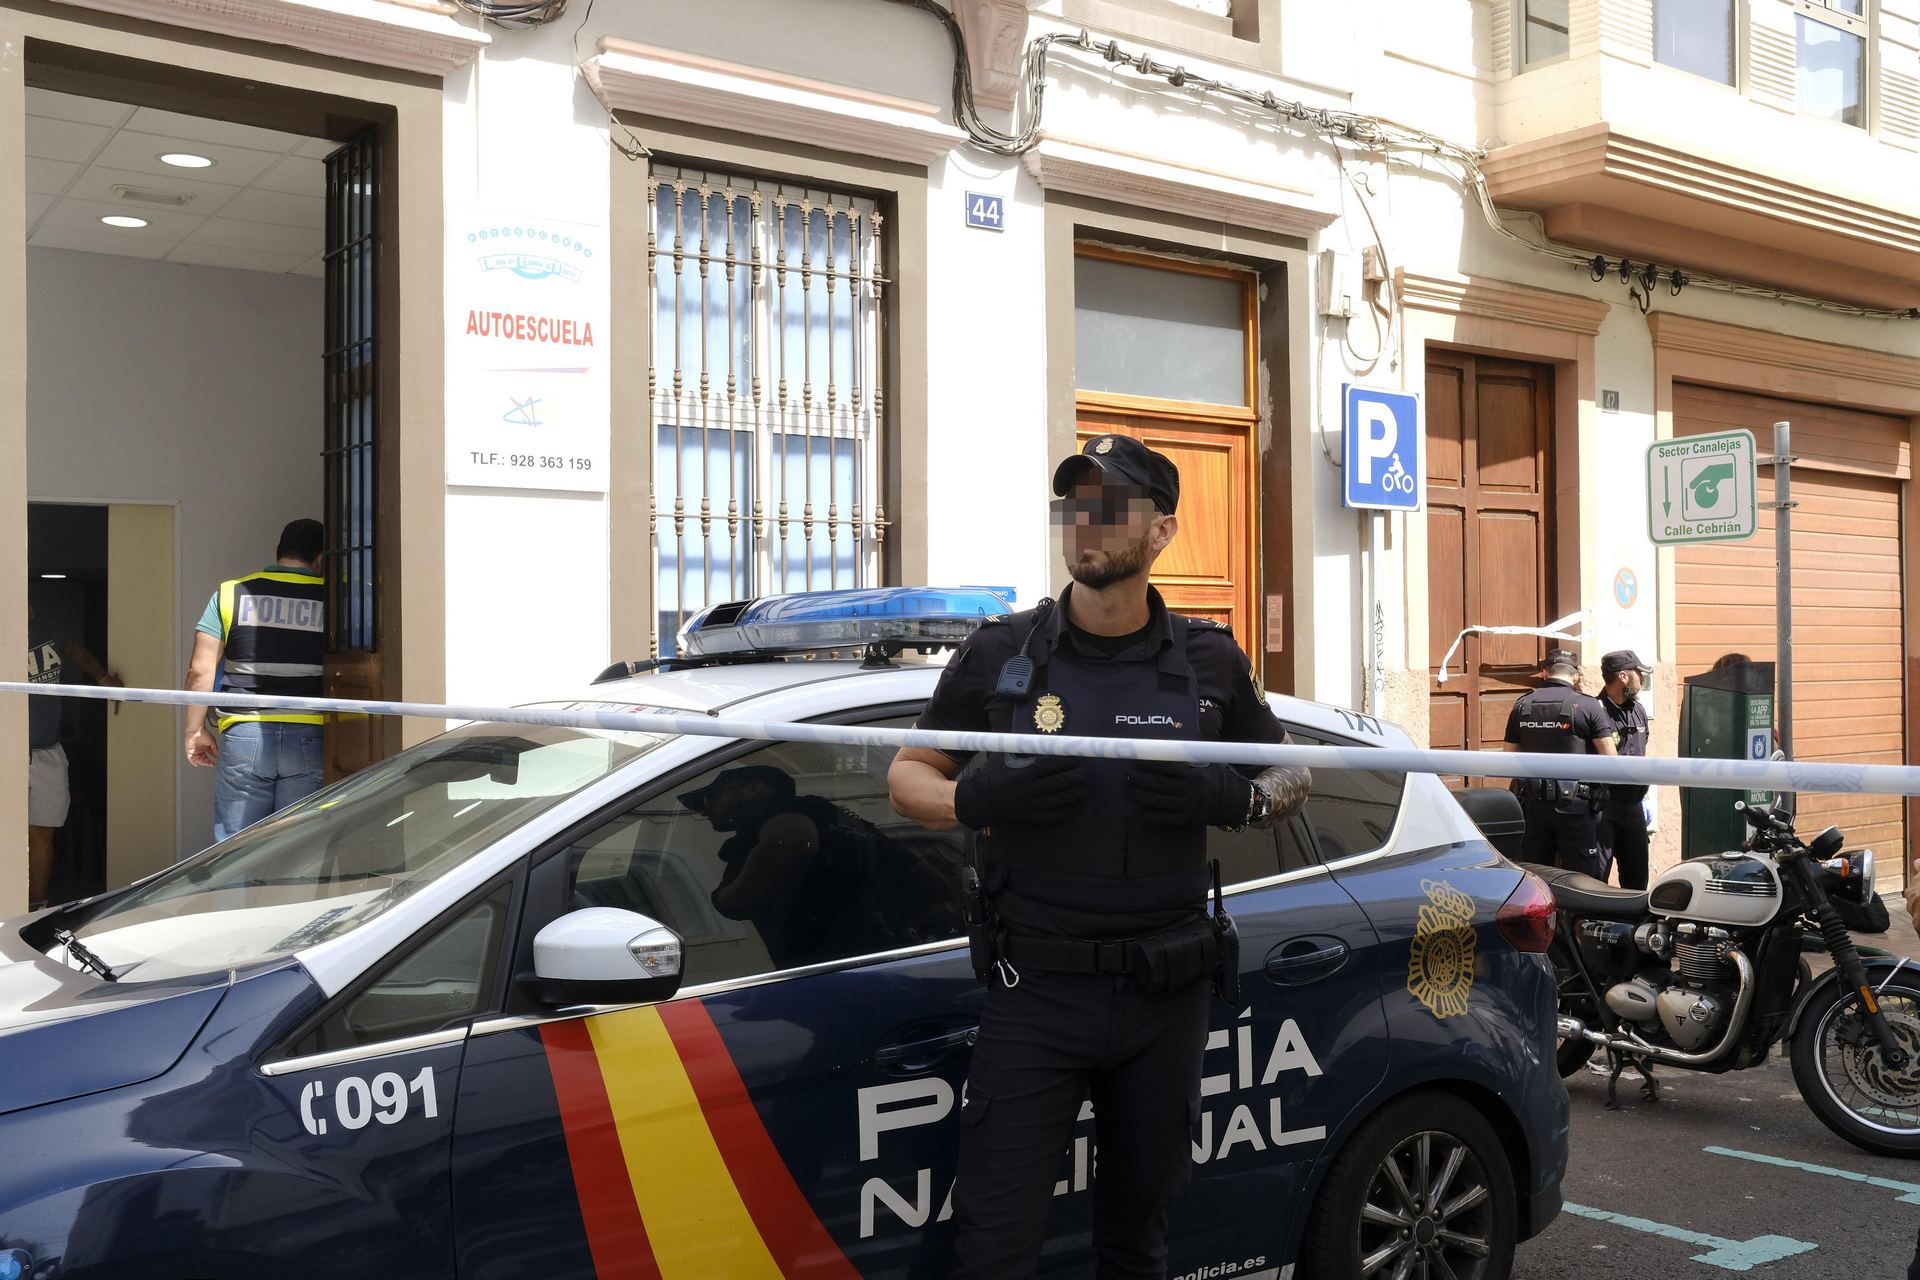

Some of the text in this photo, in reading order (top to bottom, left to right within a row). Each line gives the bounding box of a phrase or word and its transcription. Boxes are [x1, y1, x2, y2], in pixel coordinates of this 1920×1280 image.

[972, 198, 1000, 225] 44
[466, 310, 594, 346] AUTOESCUELA
[1358, 400, 1398, 484] P
[1658, 440, 1741, 458] Sector Canalejas
[470, 451, 592, 470] TLF.: 928 363 159
[1664, 521, 1742, 537] Calle Cebrián
[1115, 715, 1174, 725] POLICIA
[1519, 721, 1563, 729] POLICIA
[335, 1066, 438, 1130] 091
